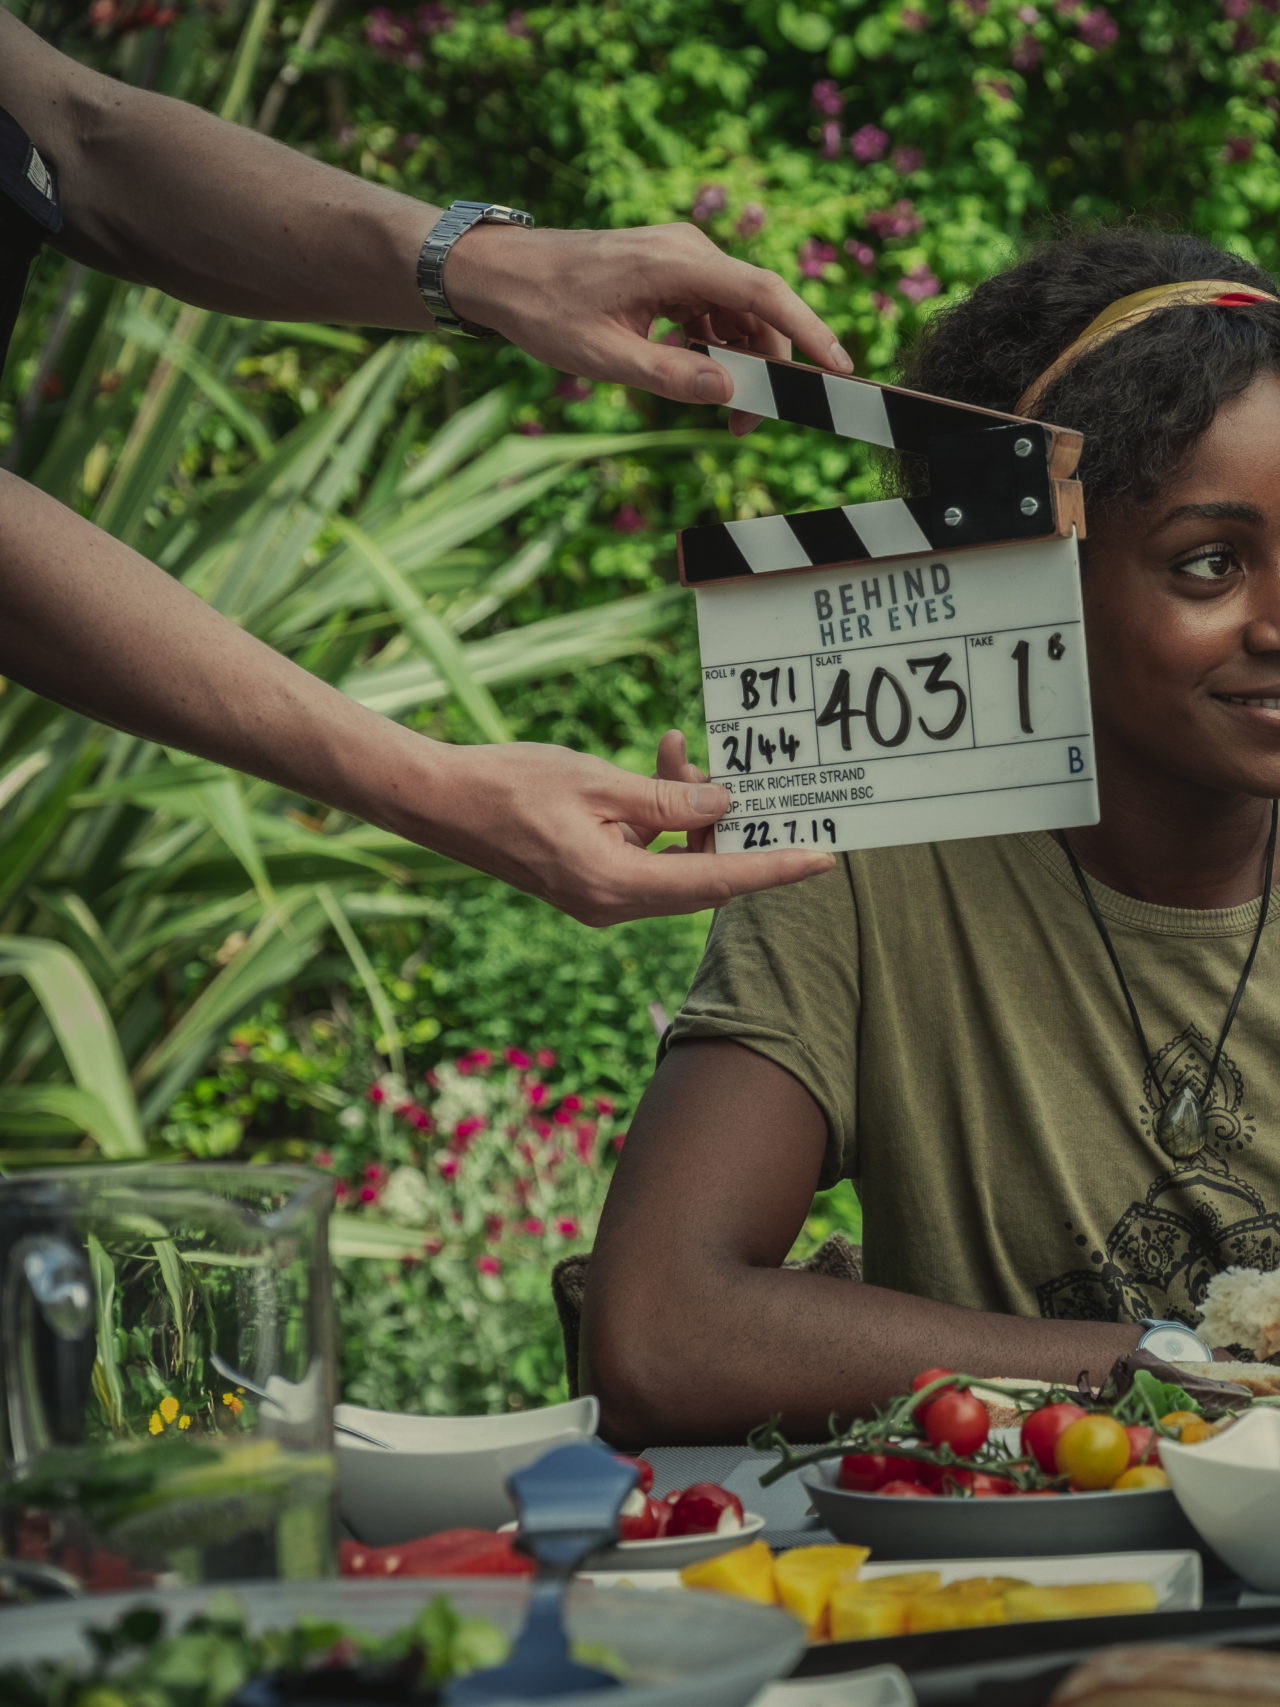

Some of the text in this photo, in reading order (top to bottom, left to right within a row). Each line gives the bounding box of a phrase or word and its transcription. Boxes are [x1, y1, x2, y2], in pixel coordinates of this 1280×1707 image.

[814, 563, 951, 621] BEHIND
[819, 594, 956, 647] HER EYES
[970, 636, 994, 648] TAKE
[705, 667, 736, 681] ROLL #
[815, 654, 843, 667] SLATE
[740, 666, 796, 711] B71
[1010, 639, 1034, 734] 1
[815, 652, 967, 751] 403
[709, 722, 740, 735] SCENE
[722, 726, 800, 774] 2/44
[1067, 746, 1085, 775] B
[739, 777, 766, 793] ERIK
[768, 773, 817, 790] RICHTER
[820, 767, 865, 784] STRAND
[746, 796, 777, 812] FELIX
[779, 788, 848, 808] WIEDEMANN
[851, 785, 874, 800] BSC
[717, 821, 741, 833] DATE
